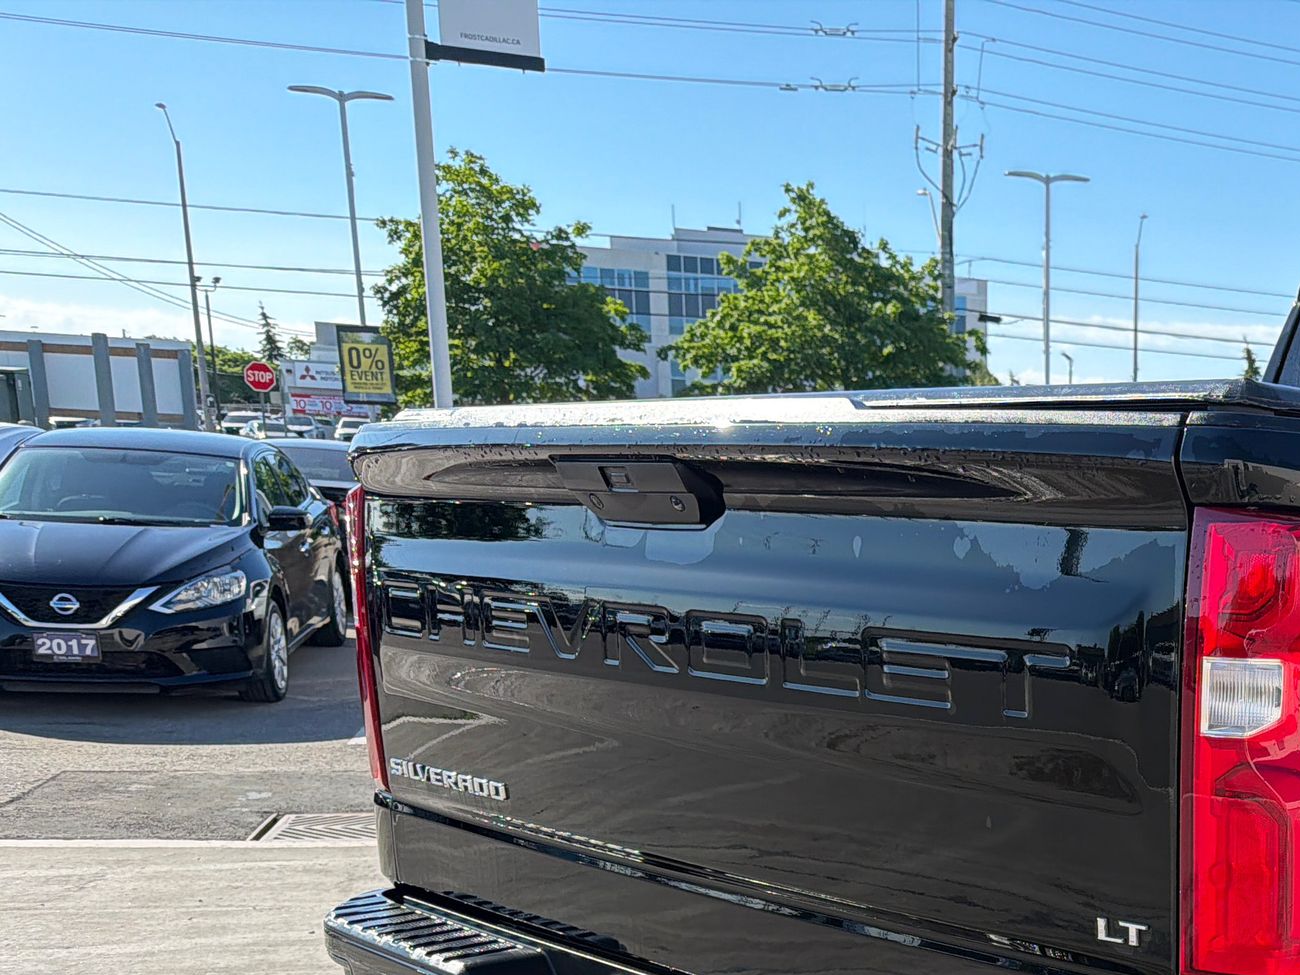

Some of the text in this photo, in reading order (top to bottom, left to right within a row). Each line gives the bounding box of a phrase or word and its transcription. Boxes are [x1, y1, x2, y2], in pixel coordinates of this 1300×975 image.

[459, 32, 521, 45] FROSTCADILLAC.CA
[348, 346, 386, 370] 0%
[247, 370, 273, 383] STOP
[350, 370, 386, 382] EVENT
[36, 637, 97, 656] 2017
[381, 578, 1072, 718] CHEVROLET
[389, 757, 509, 801] SILVERADO
[1096, 916, 1149, 947] LT
